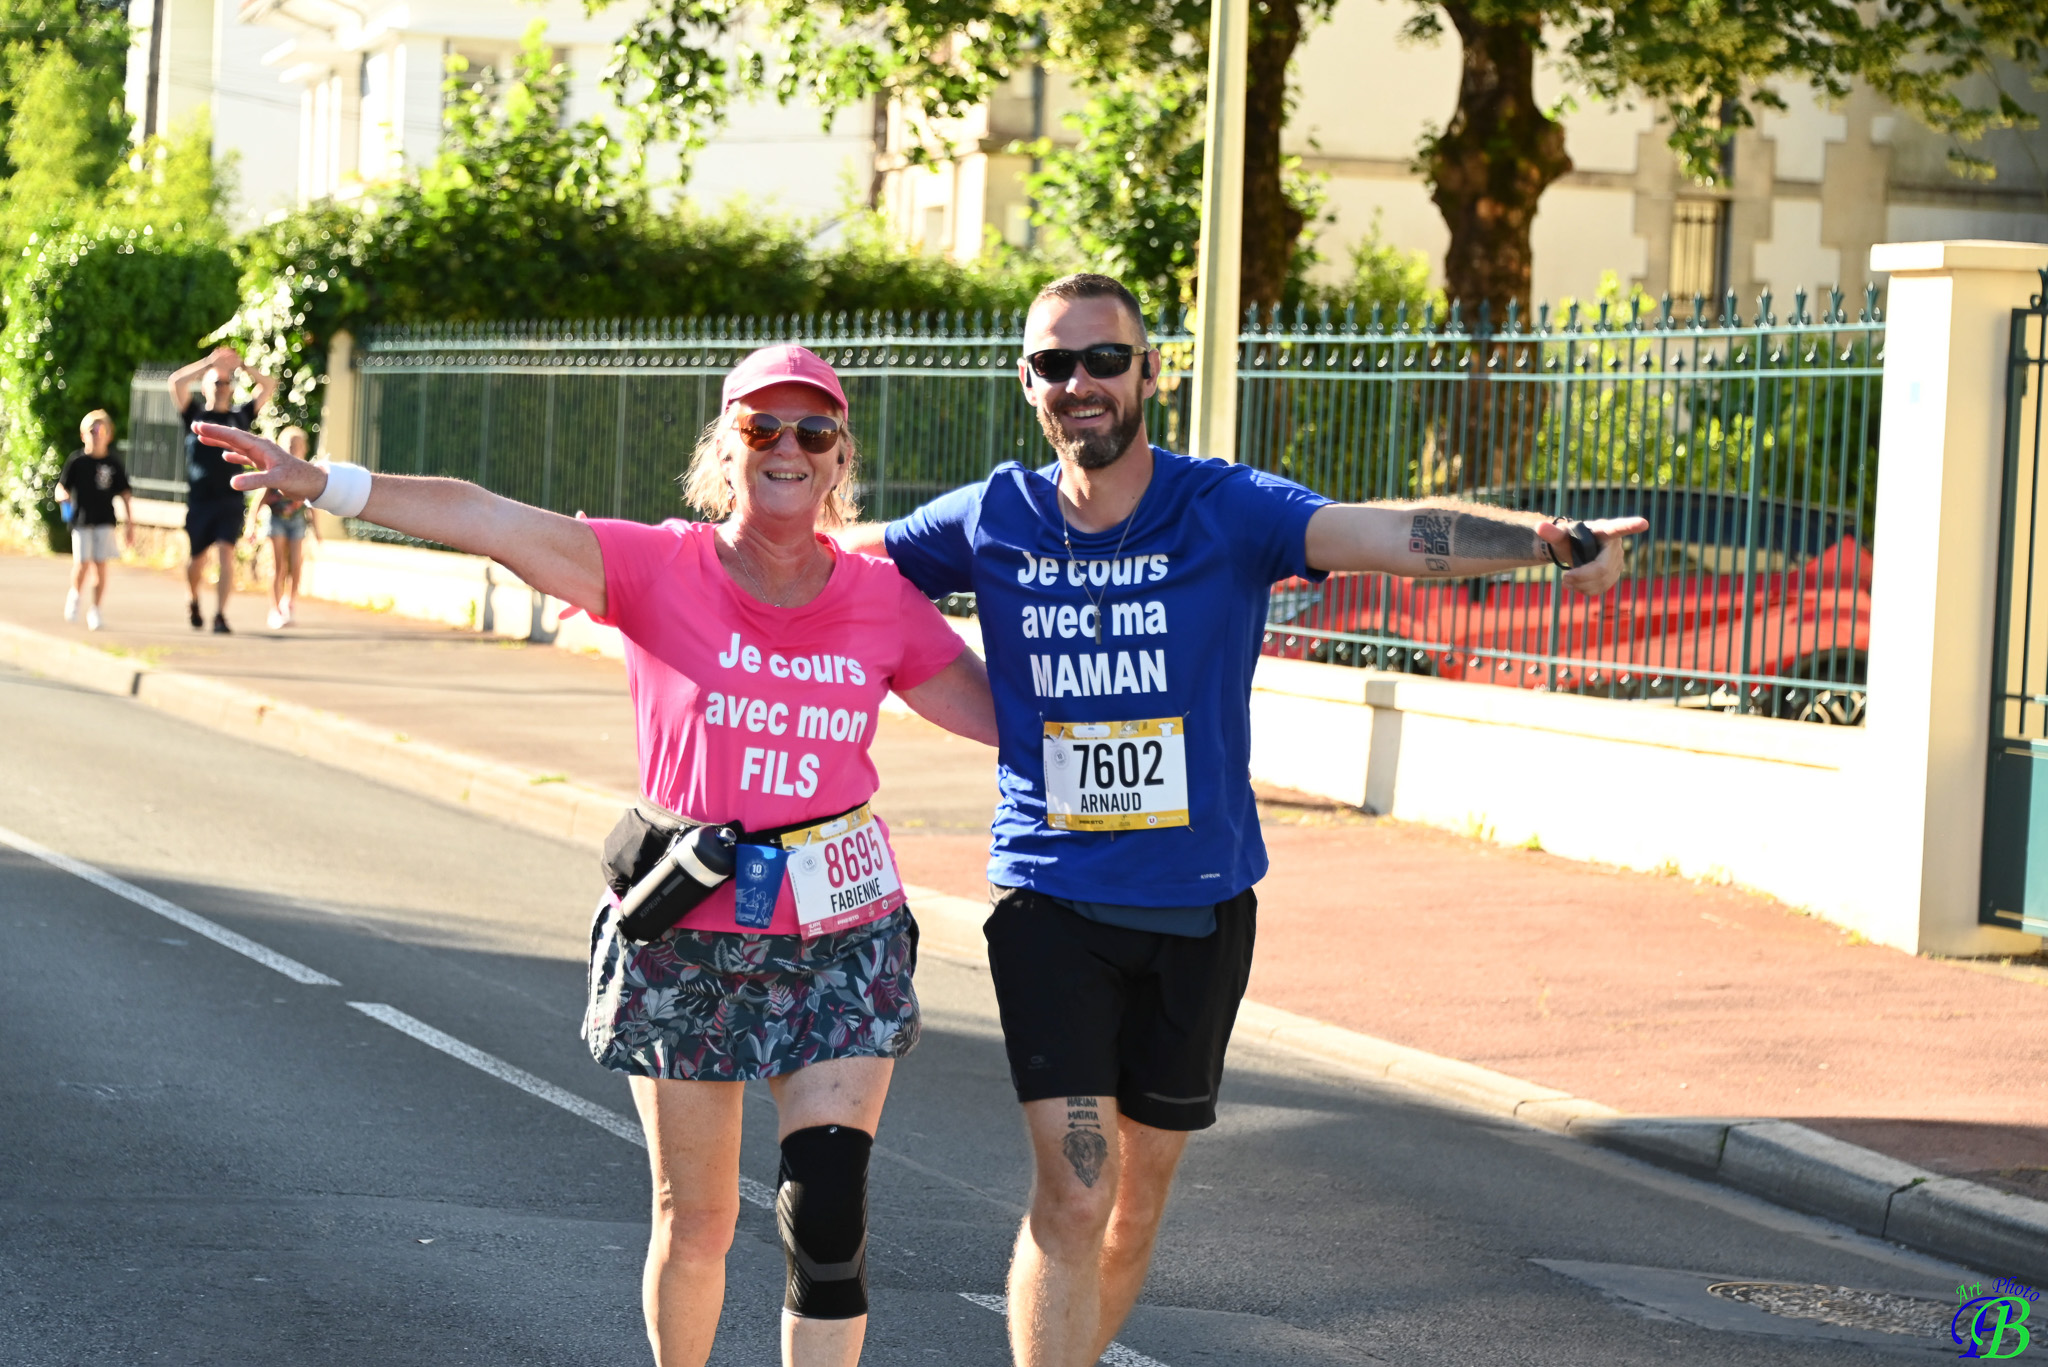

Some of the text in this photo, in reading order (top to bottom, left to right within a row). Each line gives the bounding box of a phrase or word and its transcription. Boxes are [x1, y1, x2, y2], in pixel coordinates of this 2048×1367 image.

[1017, 551, 1169, 586] Je cours
[1022, 601, 1168, 639] avec ma
[719, 633, 867, 686] Je cours
[1030, 649, 1168, 698] MAMAN
[705, 692, 868, 743] avec mon
[740, 747, 820, 798] FILS
[1073, 740, 1164, 789] 7602
[1080, 792, 1142, 813] ARNAUD
[752, 864, 762, 874] 10
[824, 826, 884, 889] 8695
[830, 877, 883, 914] FABIENNE
[1068, 1110, 1099, 1120] MATATA
